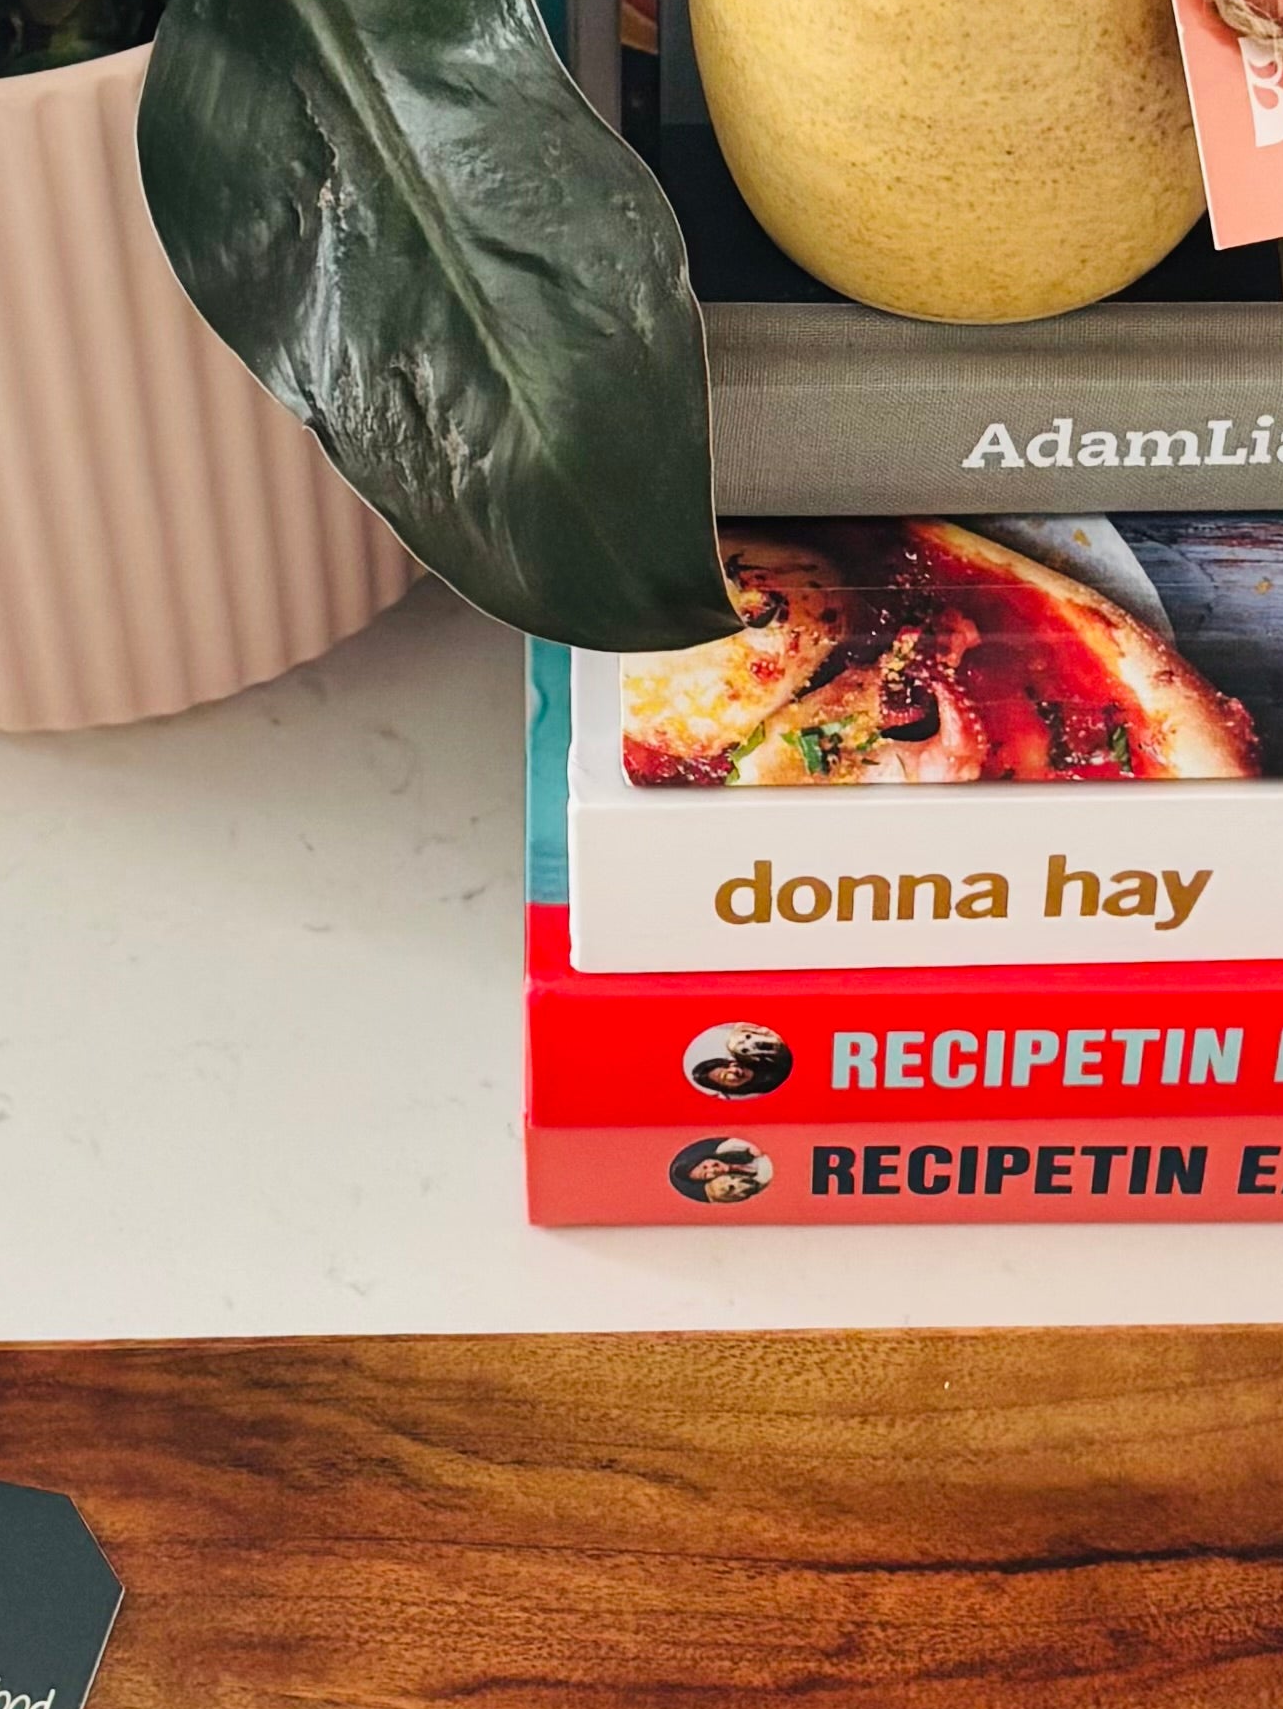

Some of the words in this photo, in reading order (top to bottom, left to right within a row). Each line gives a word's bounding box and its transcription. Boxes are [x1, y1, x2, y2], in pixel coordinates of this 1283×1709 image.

[714, 859, 1010, 925] donna
[1043, 853, 1214, 931] hay
[830, 1026, 1244, 1090] RECIPETIN
[810, 1144, 1209, 1196] RECIPETIN
